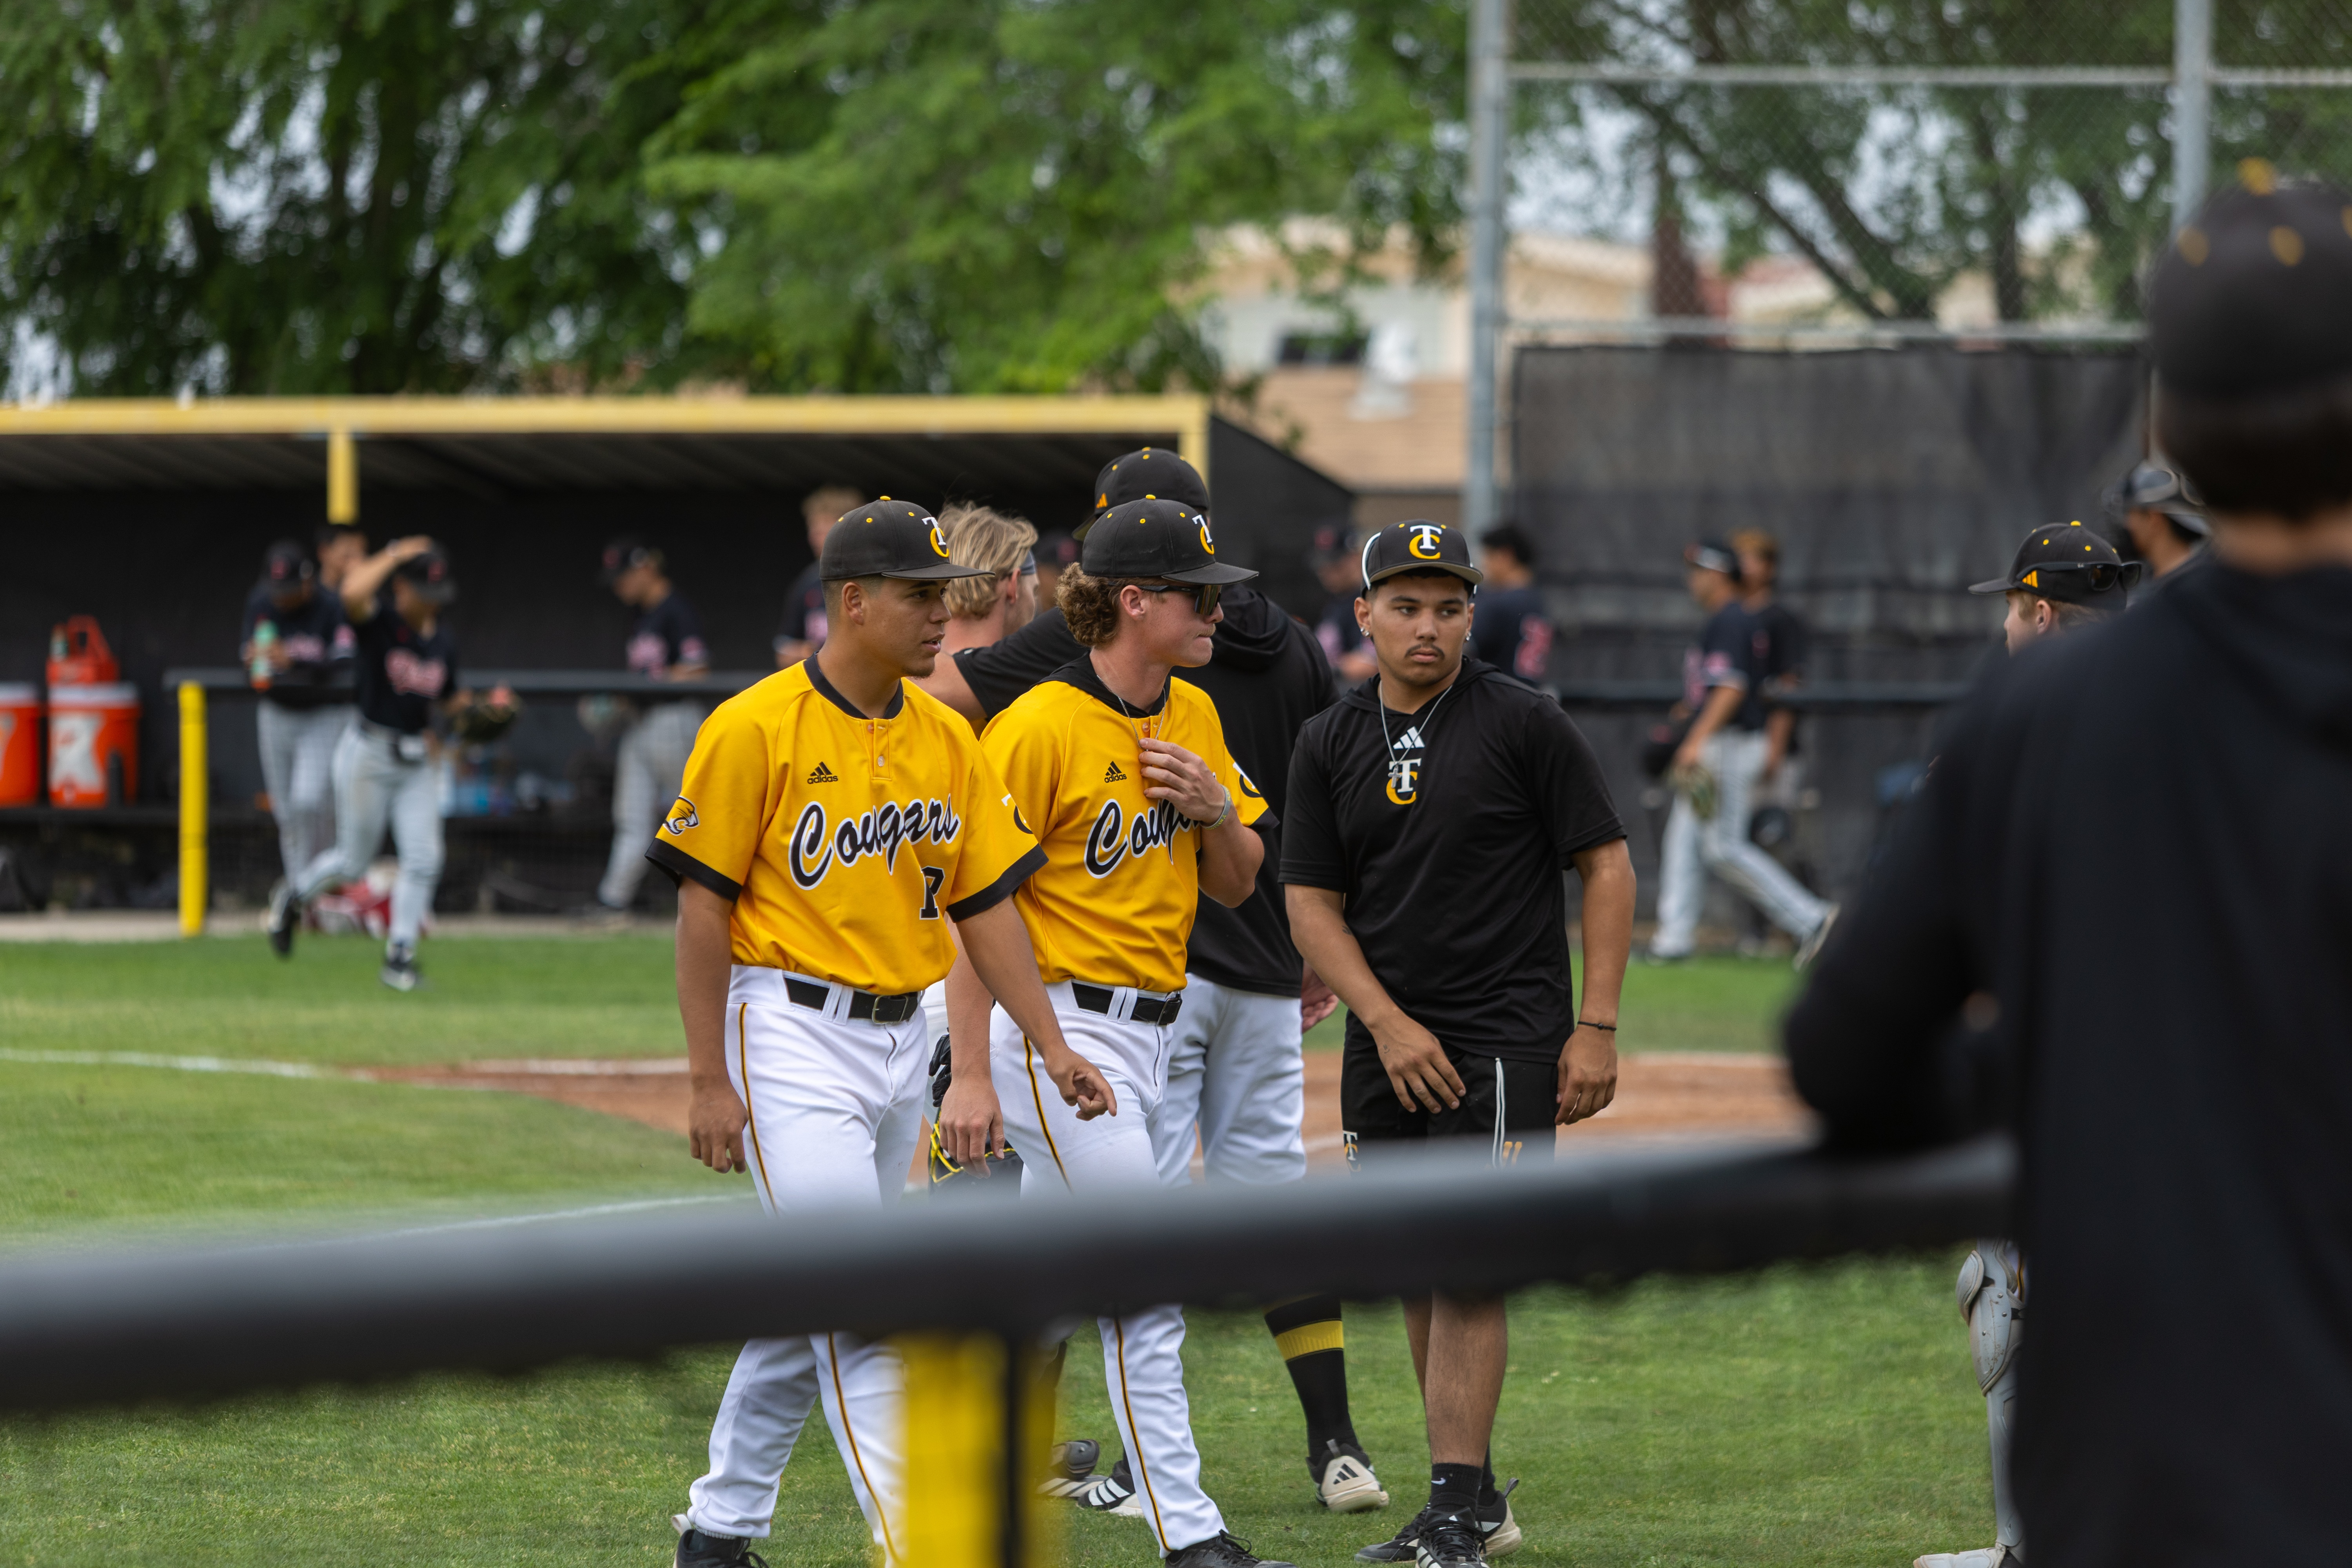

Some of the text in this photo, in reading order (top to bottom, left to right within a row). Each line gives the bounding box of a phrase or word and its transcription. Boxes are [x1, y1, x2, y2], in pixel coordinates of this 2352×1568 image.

[921, 517, 949, 557] TC
[1192, 514, 1215, 555] TC
[1408, 524, 1443, 560] TC
[807, 775, 838, 784] adidas
[1104, 773, 1127, 783] adidas
[1386, 757, 1422, 805] TC
[788, 793, 962, 890] Cougars
[1084, 799, 1201, 878] Coug
